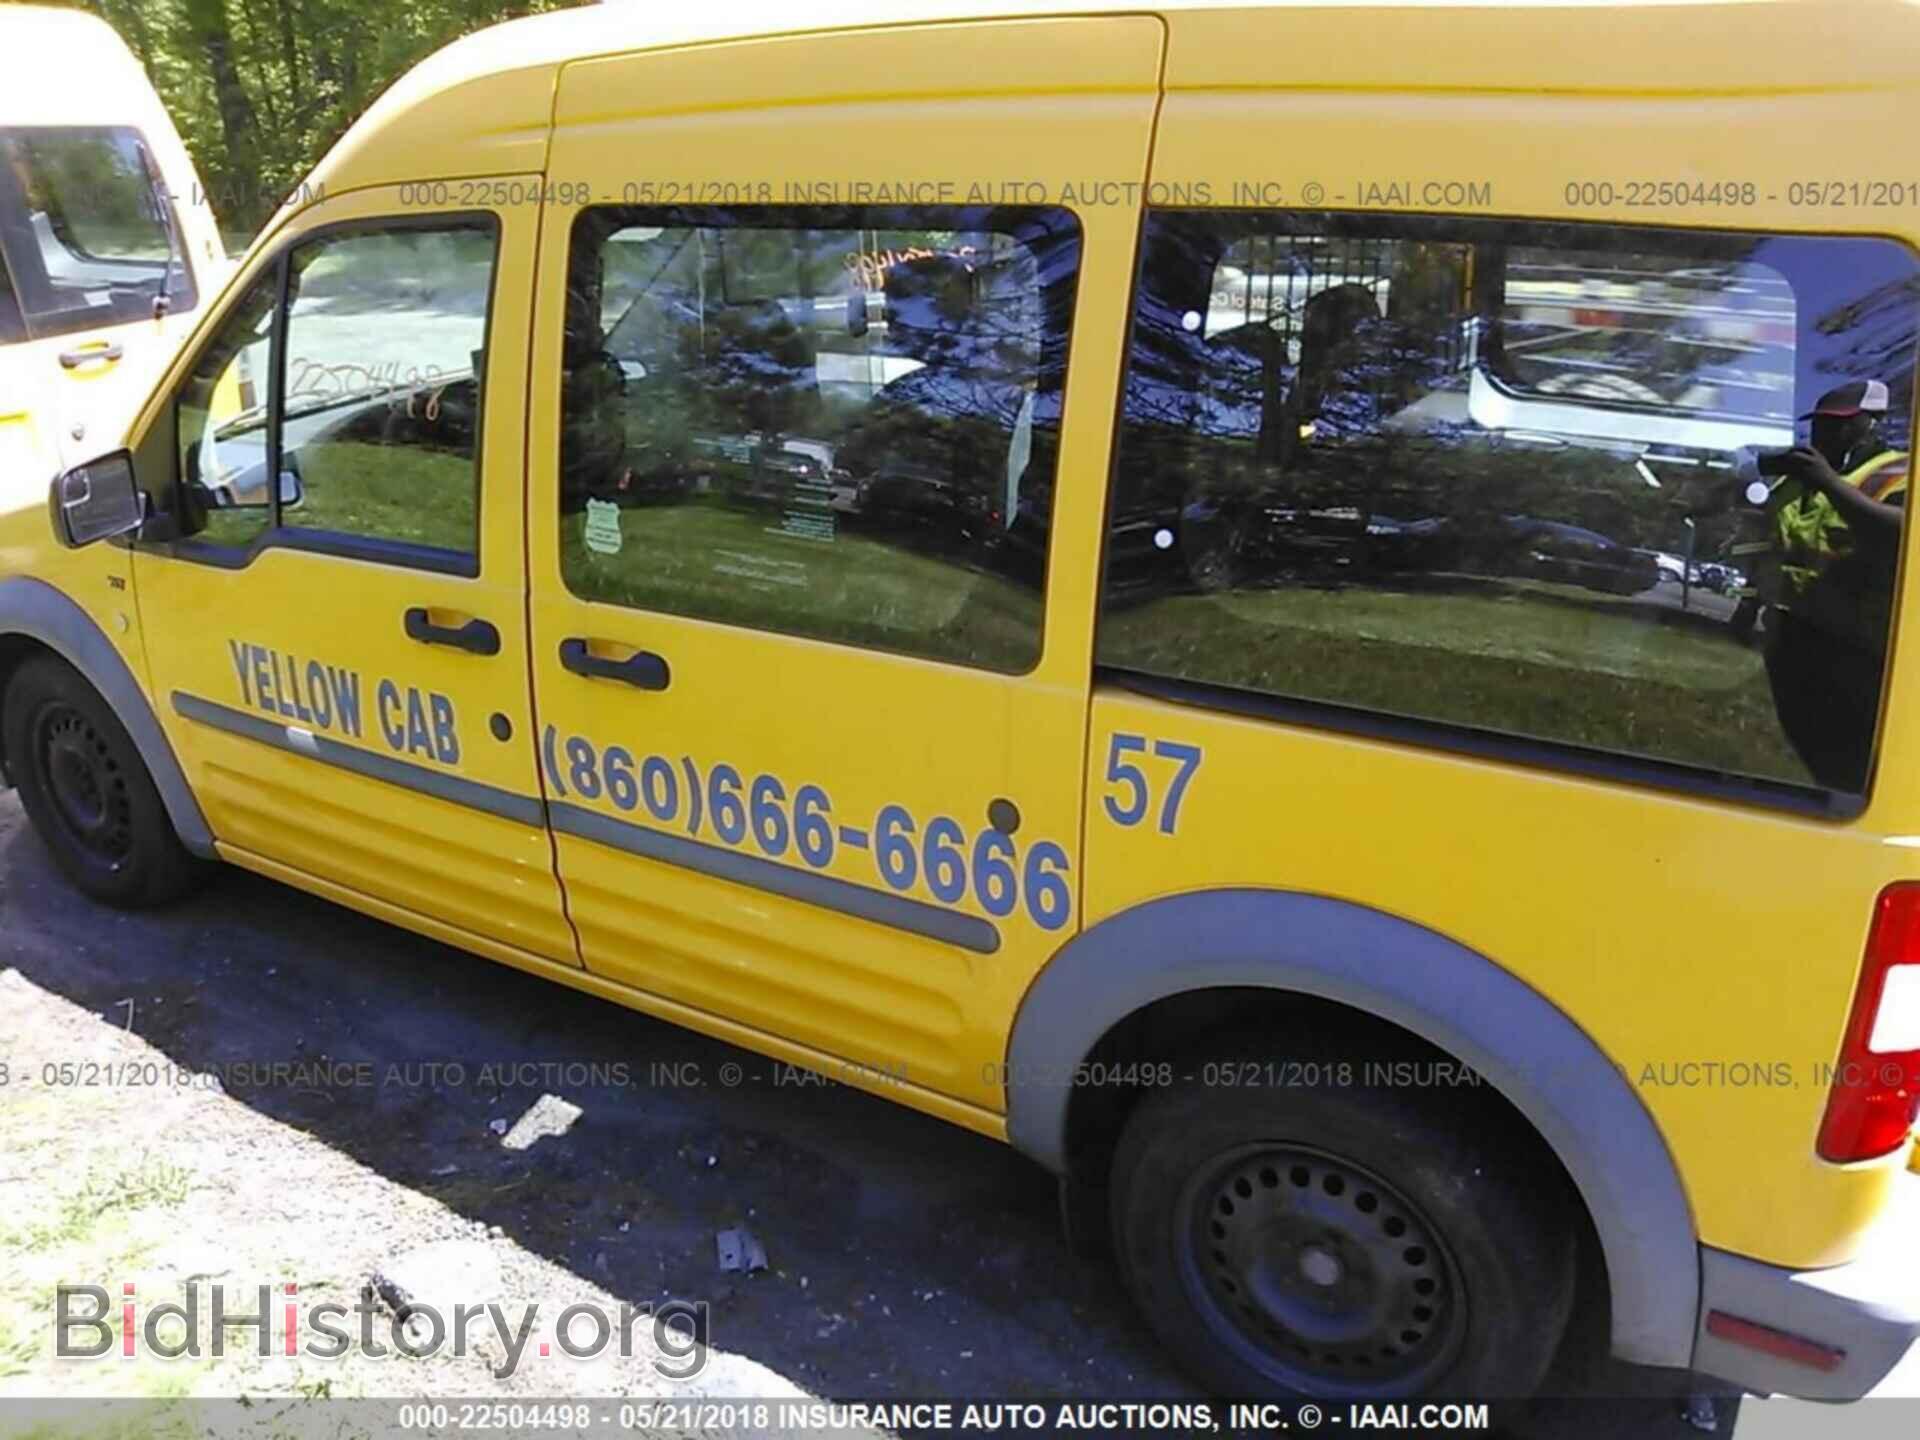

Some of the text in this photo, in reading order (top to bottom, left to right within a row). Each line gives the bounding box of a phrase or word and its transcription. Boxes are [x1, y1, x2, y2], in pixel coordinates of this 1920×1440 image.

[229, 638, 459, 765] YELLOW CAB
[543, 723, 1071, 931] (860)666-6666
[1103, 731, 1201, 837] 57
